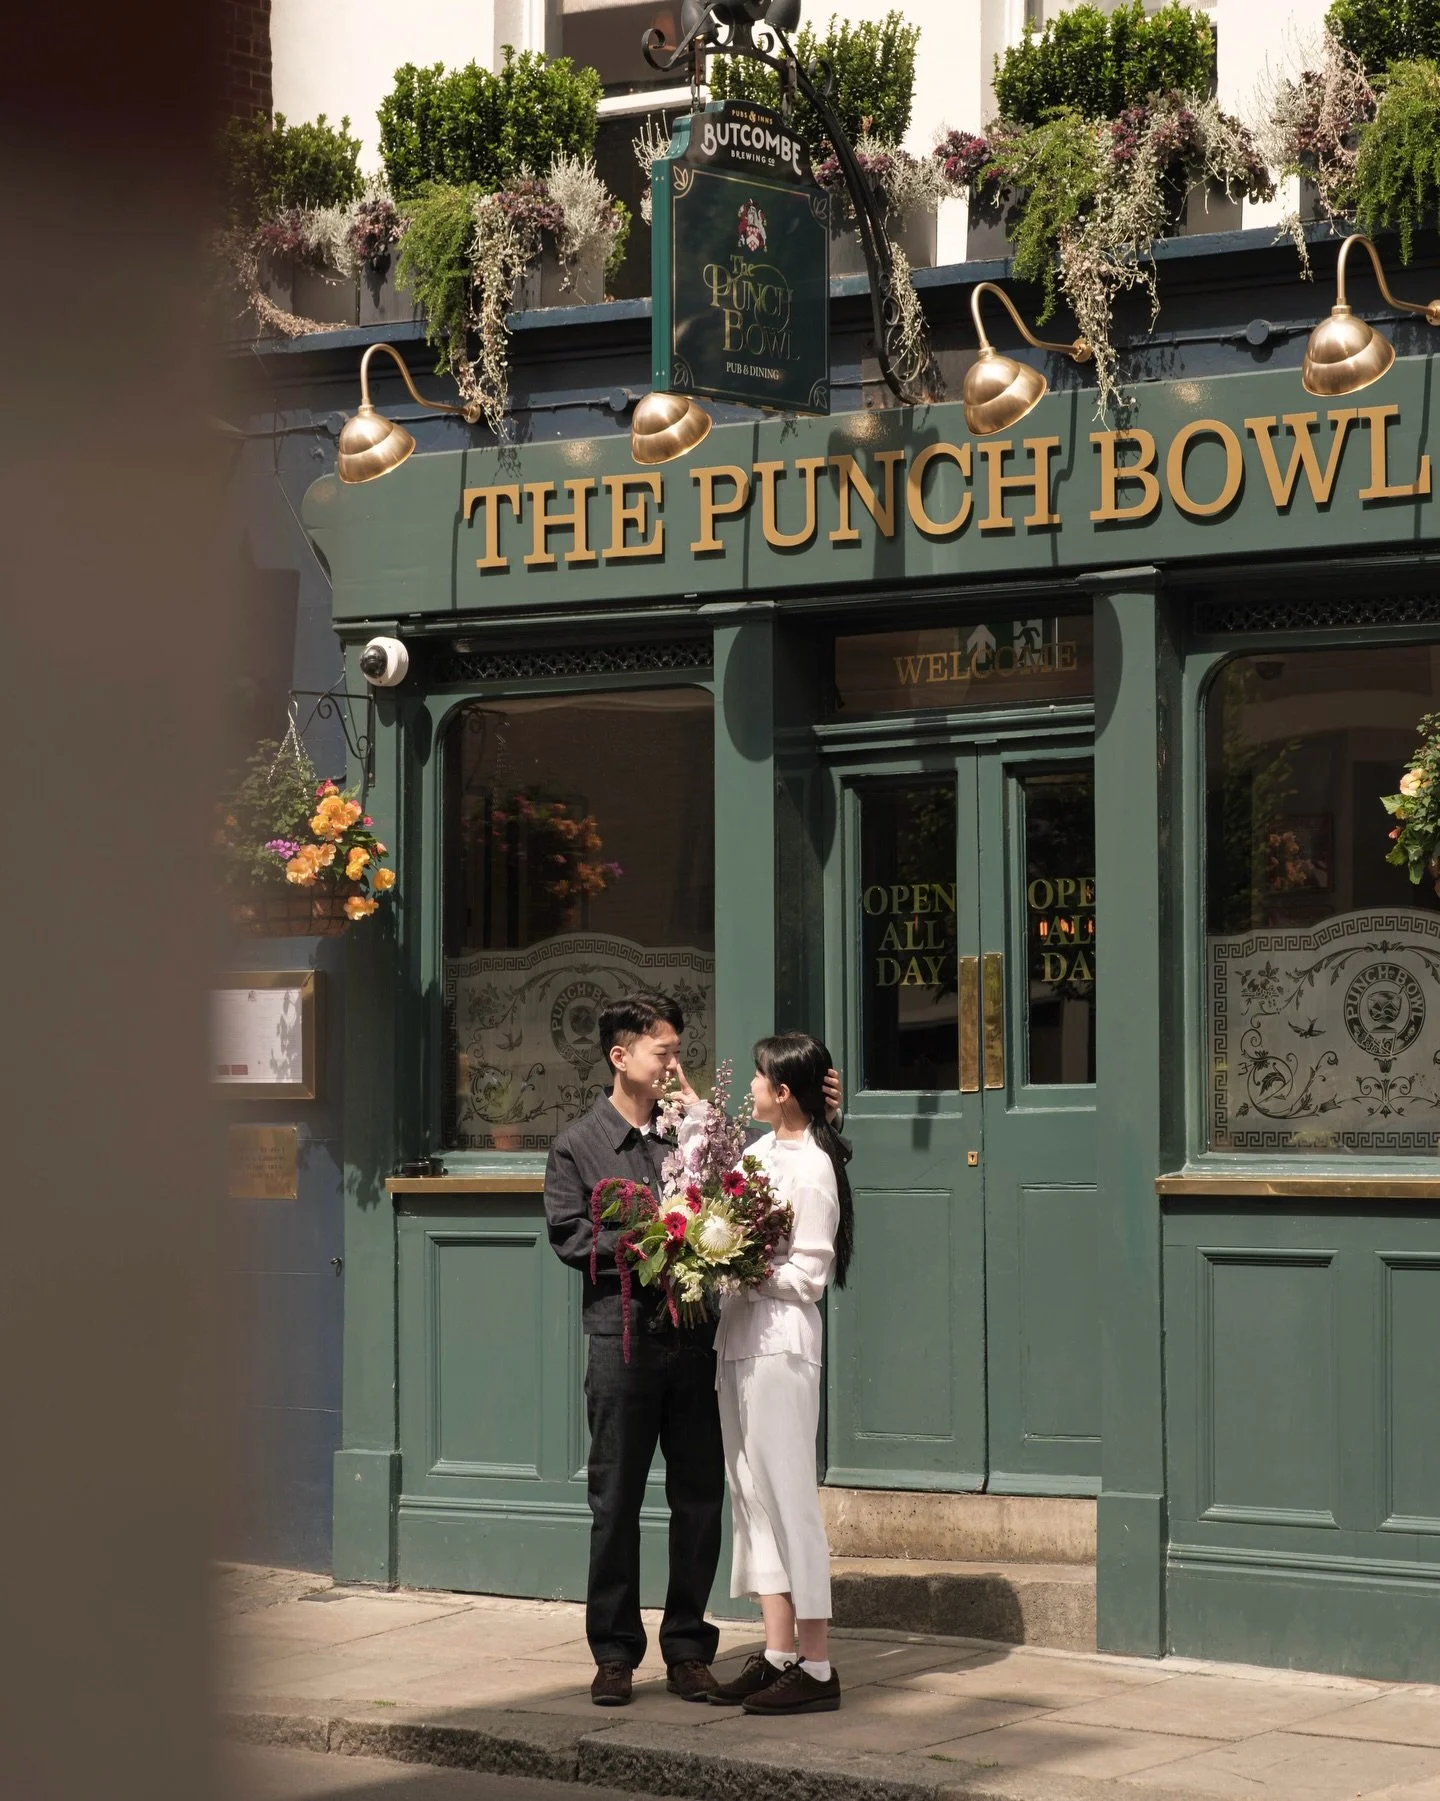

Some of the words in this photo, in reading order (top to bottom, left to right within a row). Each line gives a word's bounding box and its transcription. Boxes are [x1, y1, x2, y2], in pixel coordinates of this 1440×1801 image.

[732, 109, 748, 119] PUBS
[749, 110, 756, 123] &
[757, 115, 773, 125] INNS
[700, 122, 802, 176] BUTCOMBE
[730, 149, 766, 164] BREWING
[730, 254, 755, 277] The
[703, 263, 794, 318] PUNCH
[722, 307, 800, 361] BOWL
[726, 361, 742, 374] PUB
[743, 364, 749, 376] &
[749, 365, 780, 381] DINING
[463, 471, 663, 569] THE
[689, 436, 1062, 553] PUNCH
[1089, 404, 1432, 521] BOWL
[893, 640, 1078, 685] WELCOME
[863, 883, 957, 916] OPEN
[1028, 877, 1096, 910] OPE
[878, 920, 945, 951] ALL
[1043, 915, 1096, 946] AL
[875, 955, 947, 987] DAY
[1041, 950, 1096, 982] DA
[552, 983, 587, 1032] PUNCH
[1347, 965, 1389, 1020] PUNCH
[1395, 969, 1424, 1021] BOWL
